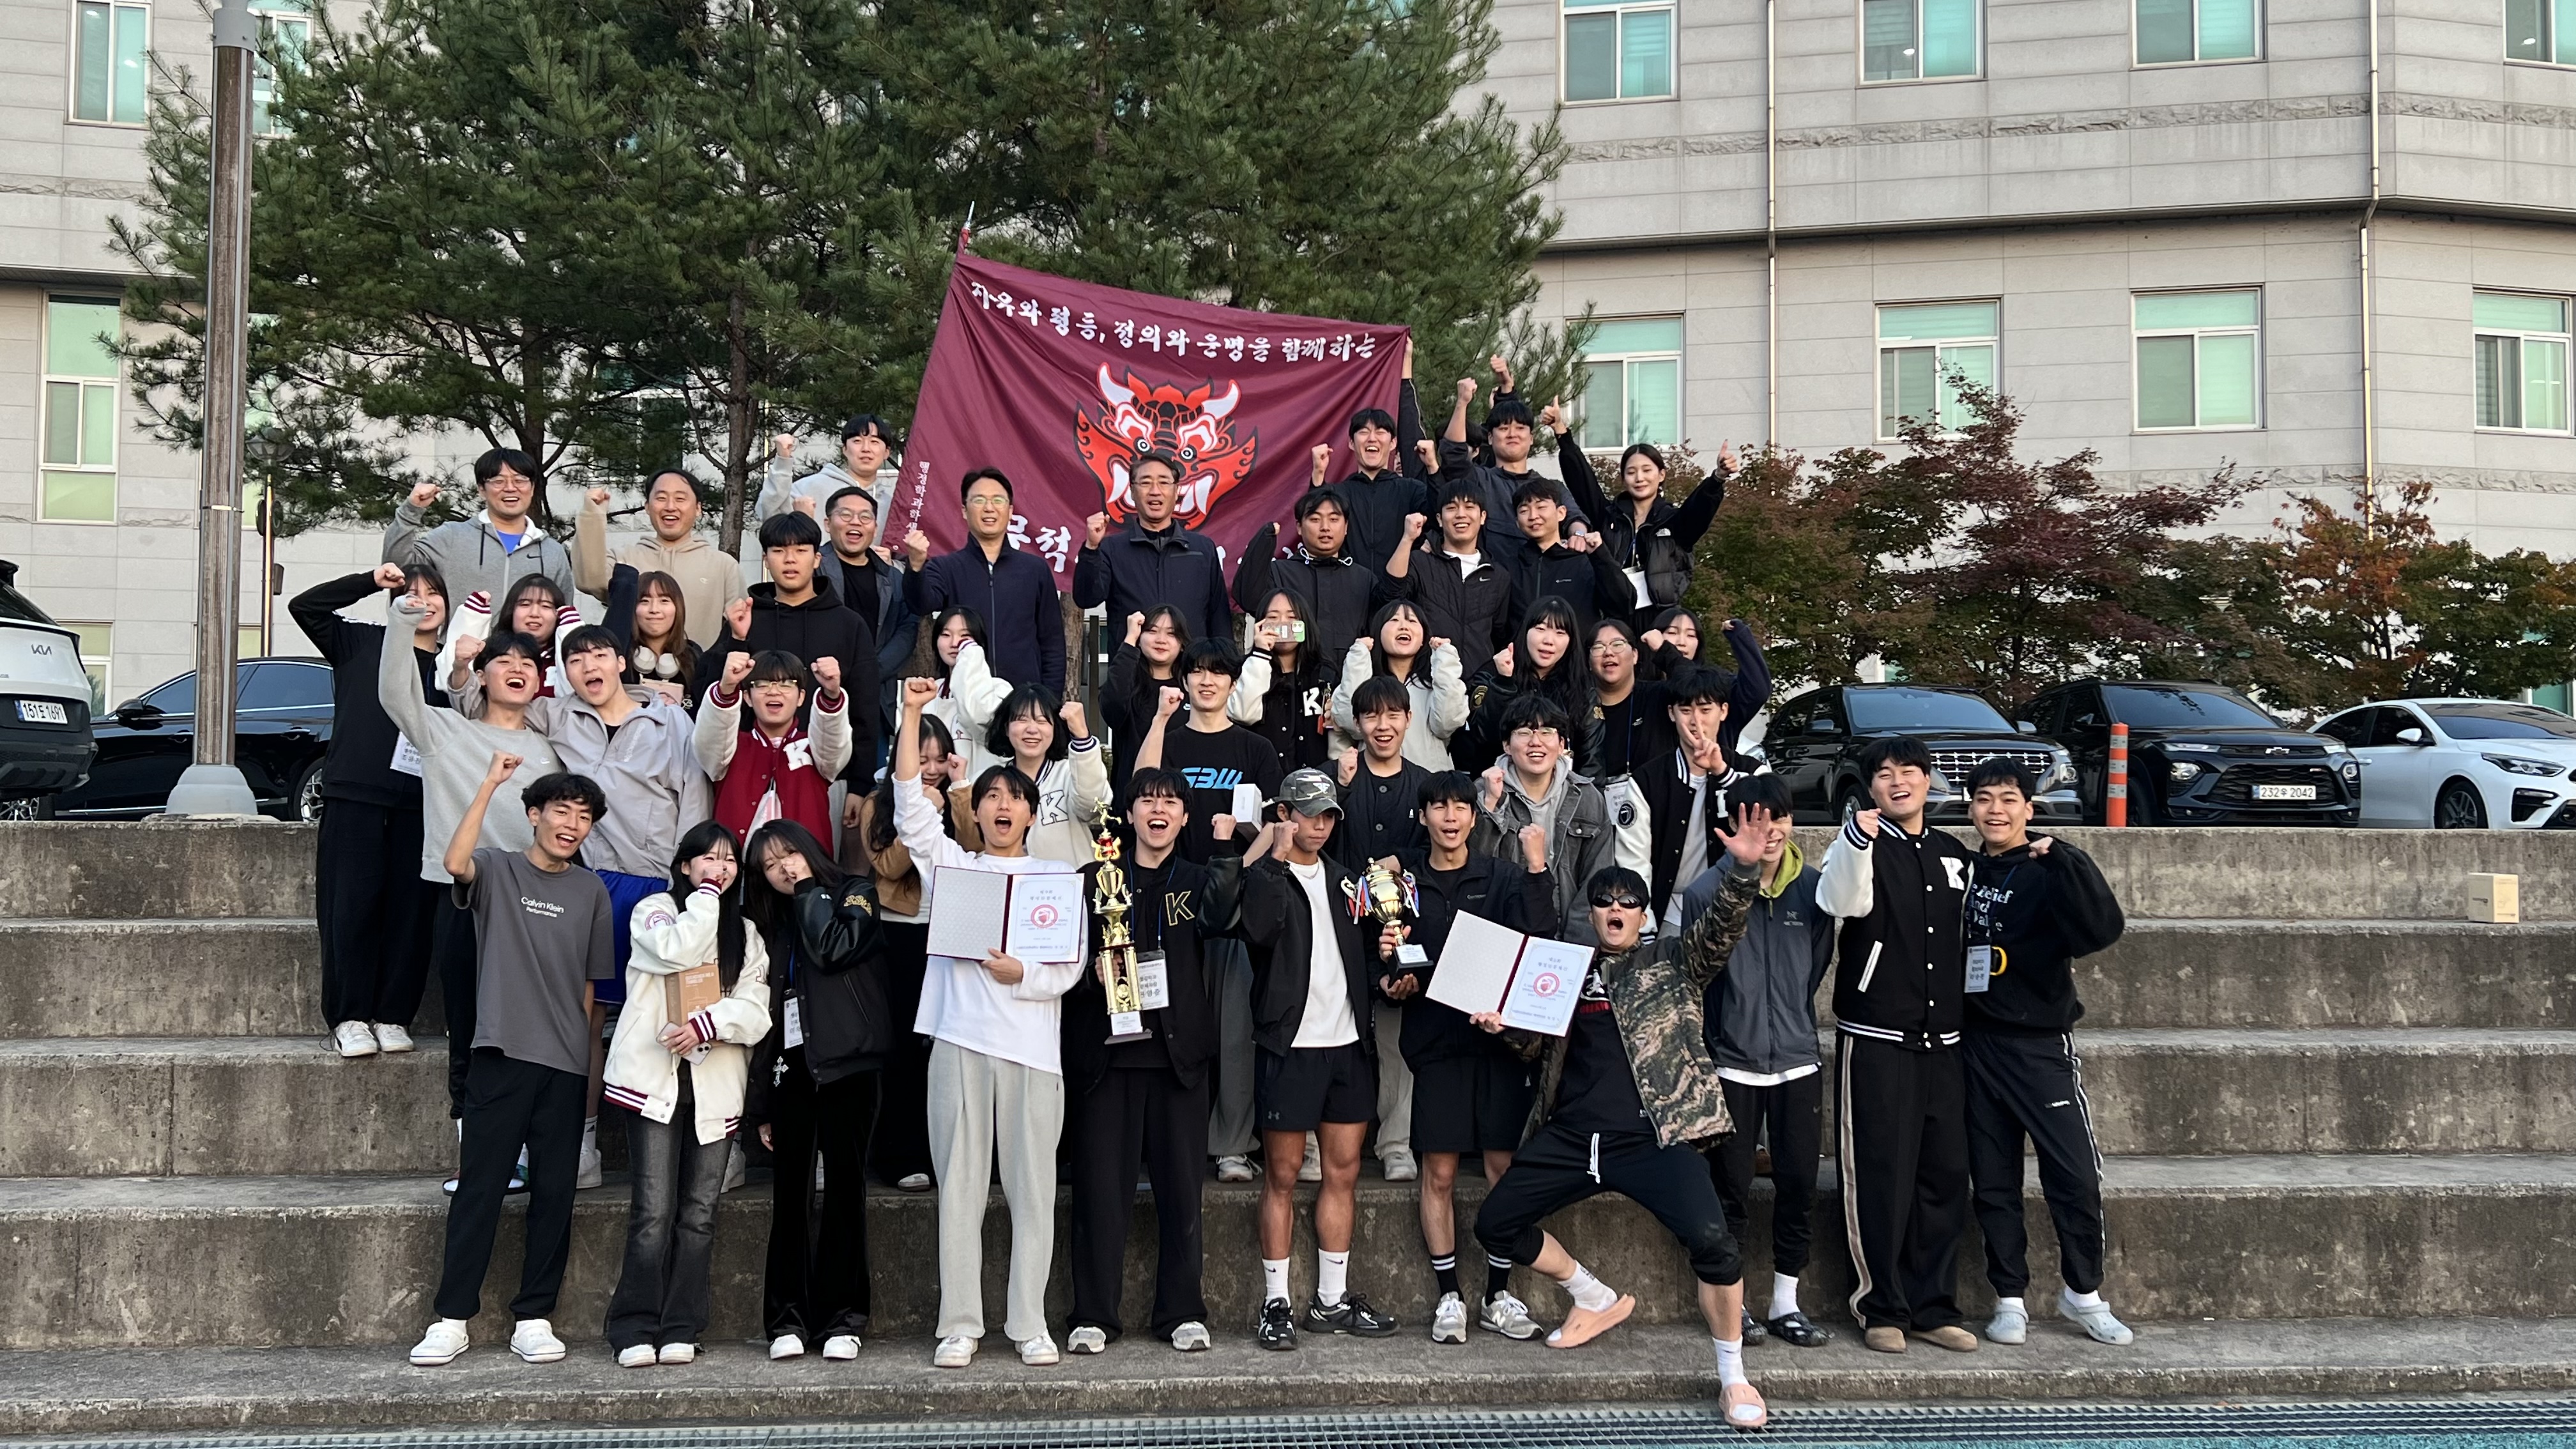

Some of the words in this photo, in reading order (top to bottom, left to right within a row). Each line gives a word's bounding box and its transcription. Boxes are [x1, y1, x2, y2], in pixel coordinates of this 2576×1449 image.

[971, 281, 1043, 326] 자유와
[1114, 319, 1190, 356] 정의와
[1196, 332, 1271, 363] 운명을
[1302, 686, 1324, 717] K
[782, 737, 813, 771] K
[1039, 789, 1070, 826] K
[1939, 856, 1965, 891] K
[521, 896, 546, 909] Calvin
[546, 902, 565, 914] Klein
[1165, 890, 1196, 926] K
